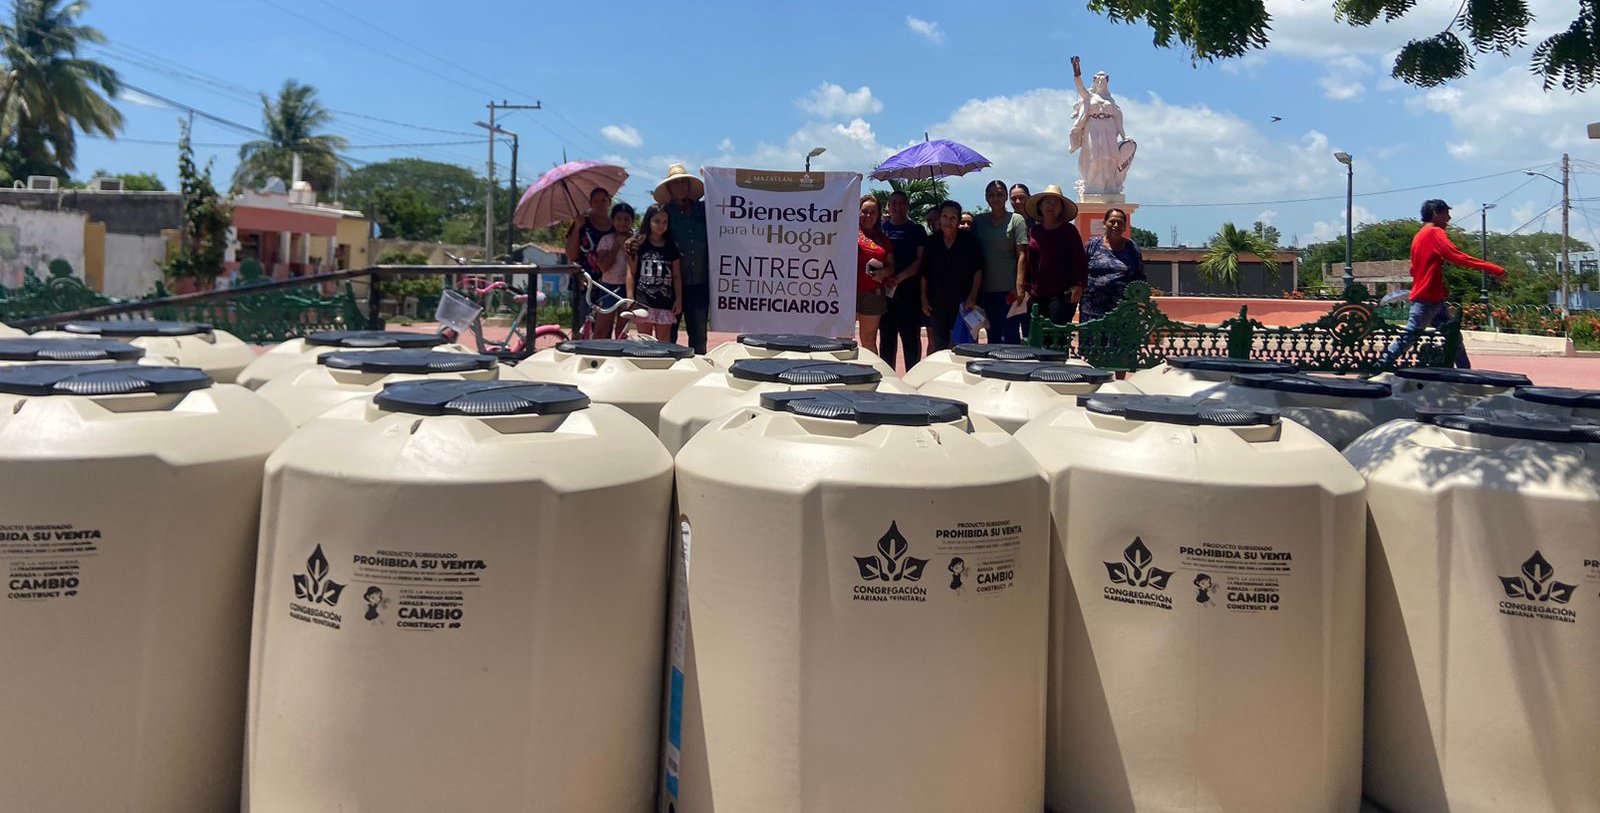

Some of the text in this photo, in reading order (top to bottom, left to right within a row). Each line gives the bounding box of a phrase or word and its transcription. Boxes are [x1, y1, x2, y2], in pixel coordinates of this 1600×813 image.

[719, 224, 838, 253] para tu Hogar
[719, 255, 838, 280] ENTREGA
[718, 278, 839, 297] DE TINACOS A
[718, 296, 839, 315] BENEFICIARIOS
[33, 532, 51, 541] SU
[54, 530, 101, 540] VENTA
[935, 525, 1022, 539] PROHIBIDA SU VENTA
[1202, 542, 1237, 551] PRODUCTO
[376, 550, 414, 559] PRODUCTO
[1180, 547, 1292, 561] PROHIBIDA SU VENTA
[353, 555, 418, 570] PROHIBIDA
[421, 559, 438, 570] SU
[9, 577, 79, 591] CAMBIO
[976, 570, 1014, 585] CAMBIO
[853, 585, 928, 596] CONGREGACIÓN
[1103, 586, 1173, 605] CONGREGACIÓN
[853, 594, 888, 602] MARIANA
[1227, 592, 1280, 604] CAMBIO
[398, 607, 464, 621] CAMBIO
[1499, 600, 1577, 618] CONGREGACIÓN
